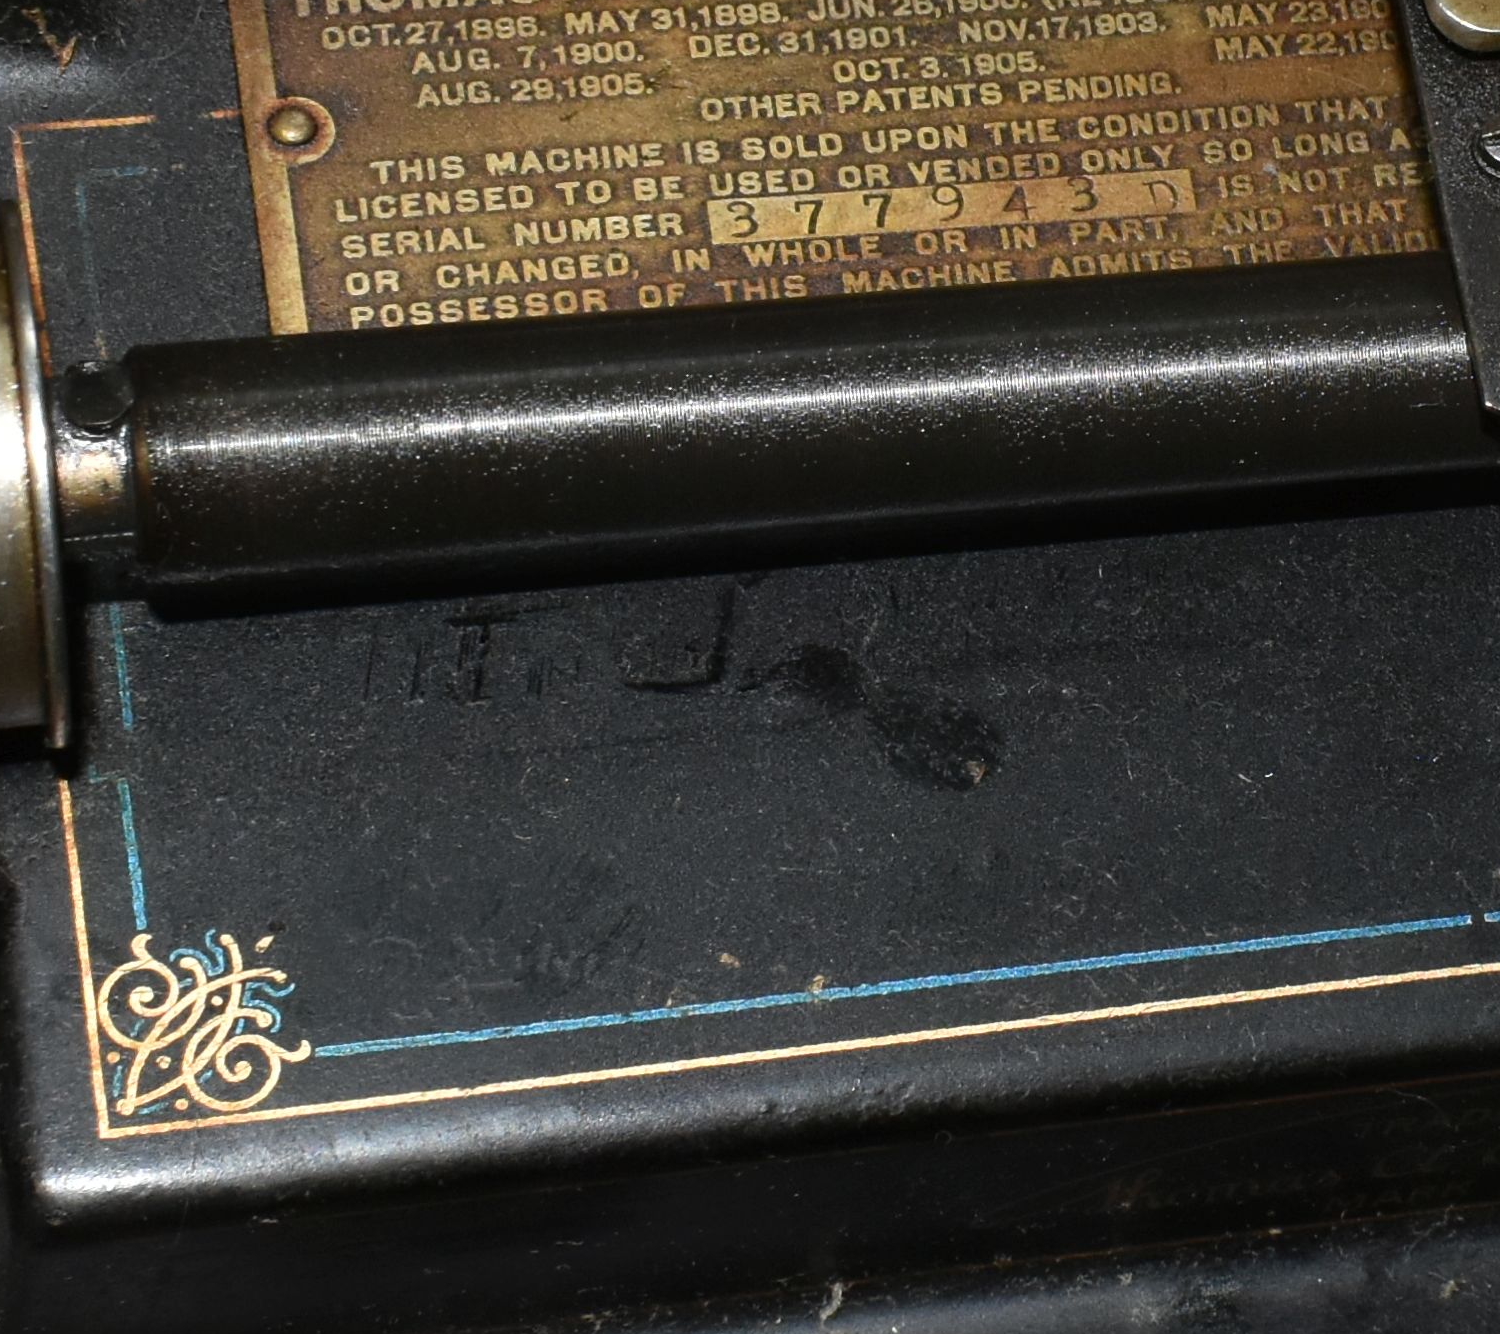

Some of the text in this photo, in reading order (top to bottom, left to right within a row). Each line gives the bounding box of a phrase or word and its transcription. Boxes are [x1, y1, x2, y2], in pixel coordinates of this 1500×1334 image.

[411, 49, 500, 75] AUG.
[689, 33, 770, 59] DEC.
[1206, 2, 1277, 28] MAY
[565, 9, 640, 36] MAY
[417, 81, 500, 109] AUG.
[833, 57, 910, 83] OCT.
[961, 50, 1047, 77] 1905.
[1214, 33, 1287, 62] MAY
[700, 71, 1182, 122] OTHER PATENTS PENDING.
[336, 183, 535, 224] LICENSED
[555, 179, 612, 207] TO
[633, 175, 685, 202] BE
[710, 165, 816, 197] USED
[836, 162, 889, 189] OR
[900, 152, 1060, 185] VENDED
[1081, 143, 1174, 175] ONLY
[1203, 137, 1254, 165] SO
[1271, 129, 1370, 160] LONG
[370, 95, 1388, 186] THIS MACHINE IS SOLD UPON THE CONDITION THAT
[341, 227, 485, 259] SERIAL
[514, 212, 685, 248] NUMBER
[1218, 173, 1255, 199] IS
[1277, 165, 1351, 195] NOT
[345, 198, 1409, 296] OR CHANGED, IN WHOLE OR IN PART, AND THAT
[350, 289, 609, 331] POSSESSOR
[637, 283, 688, 309] OF
[717, 274, 808, 304] THIS
[841, 261, 1015, 295] MACHINE
[1050, 248, 1193, 280] ADMITS
[1223, 240, 1295, 266] THE
